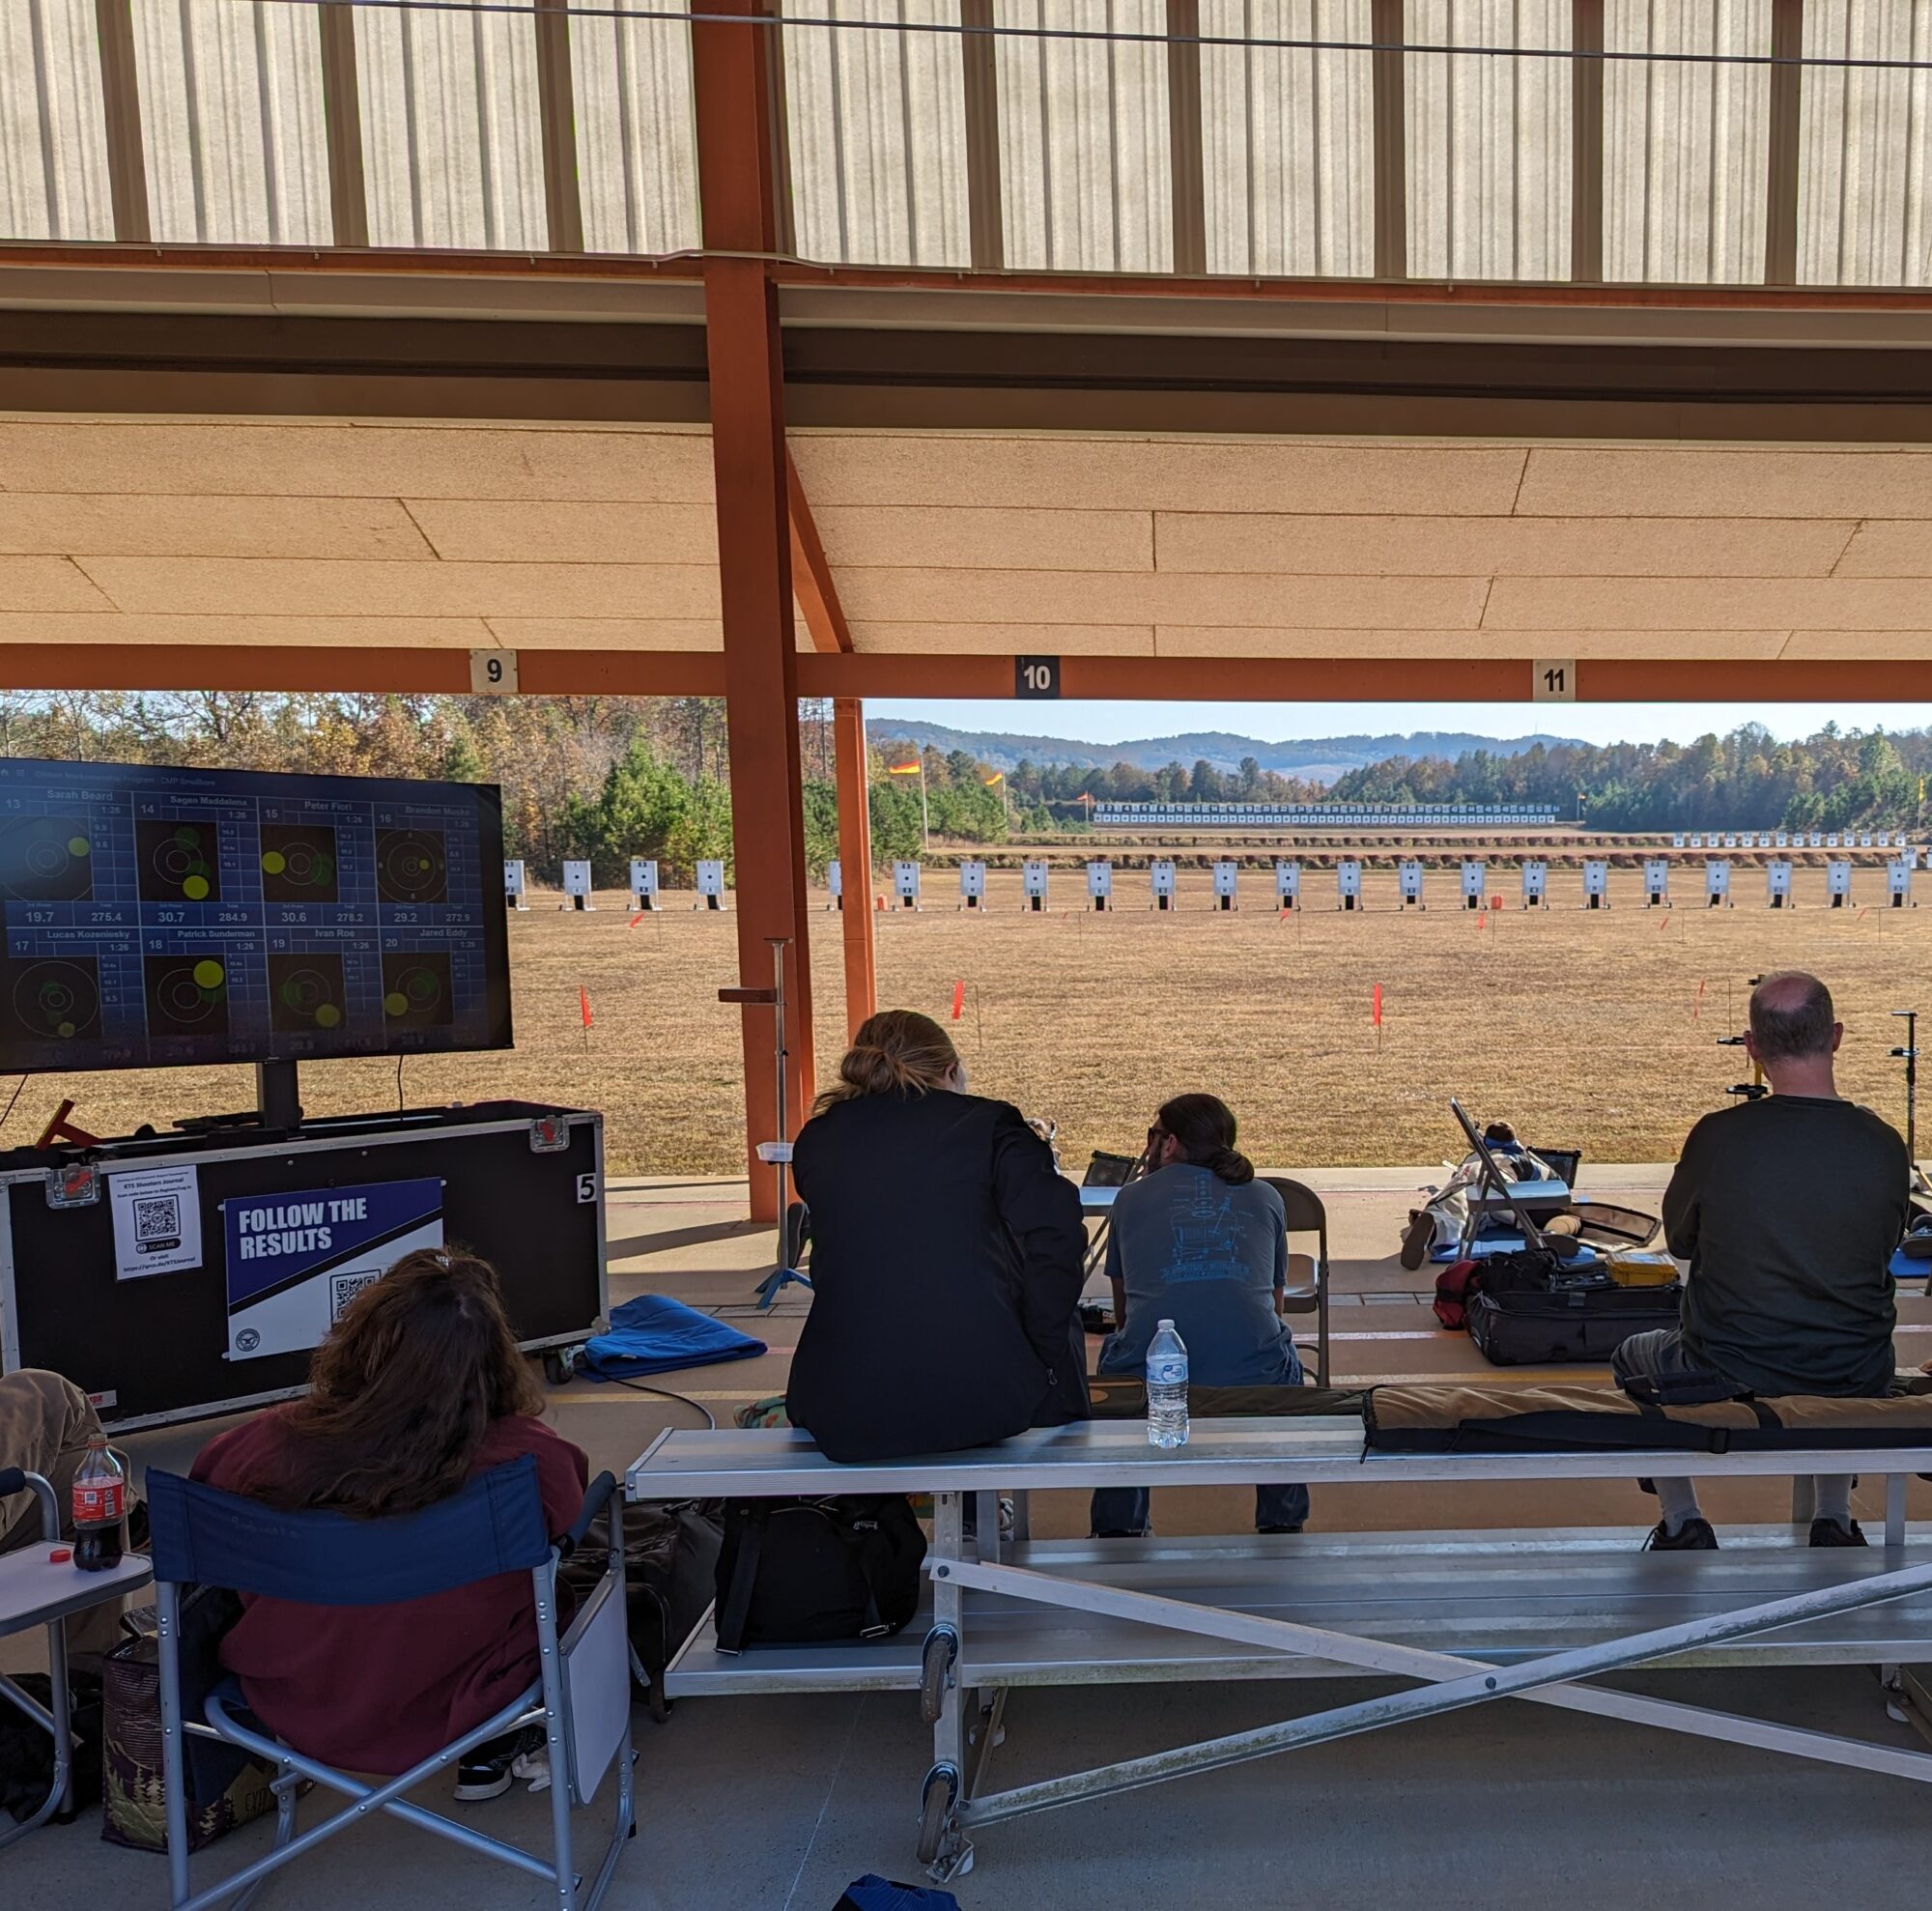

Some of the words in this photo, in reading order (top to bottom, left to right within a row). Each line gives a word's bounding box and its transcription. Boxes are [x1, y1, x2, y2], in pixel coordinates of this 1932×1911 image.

[487, 658, 502, 683] 9
[1024, 665, 1051, 690] 10
[1544, 669, 1564, 692] 11
[46, 789, 77, 799] Sarah
[81, 791, 113, 801] Beard
[5, 799, 20, 809] 13
[170, 796, 198, 805] Sagen
[140, 805, 155, 814] 14
[304, 801, 328, 811] Peter
[265, 809, 278, 818] 15
[379, 814, 391, 823] 16
[25, 912, 54, 923] 19.7
[91, 912, 123, 922] 275.4
[157, 912, 185, 923] 30.7
[218, 913, 247, 922] 284.9
[281, 912, 307, 923] 30.6
[336, 913, 364, 922] 278.2
[394, 913, 417, 923] 29.2
[445, 913, 470, 922] 272.9
[46, 930, 75, 939] Lucas
[77, 930, 129, 940] Kozeniesky
[419, 928, 444, 937] Jared
[445, 928, 469, 937] Eddy
[14, 941, 29, 951] 17
[149, 939, 162, 950] 18
[272, 939, 286, 949] 19
[385, 938, 398, 948] 20
[136, 1179, 162, 1188] Shooters
[163, 1177, 185, 1185] Journal
[581, 1176, 595, 1200] 5
[239, 1202, 325, 1234] FOLLOW
[328, 1197, 367, 1223] THE
[241, 1226, 332, 1260] RESULTS
